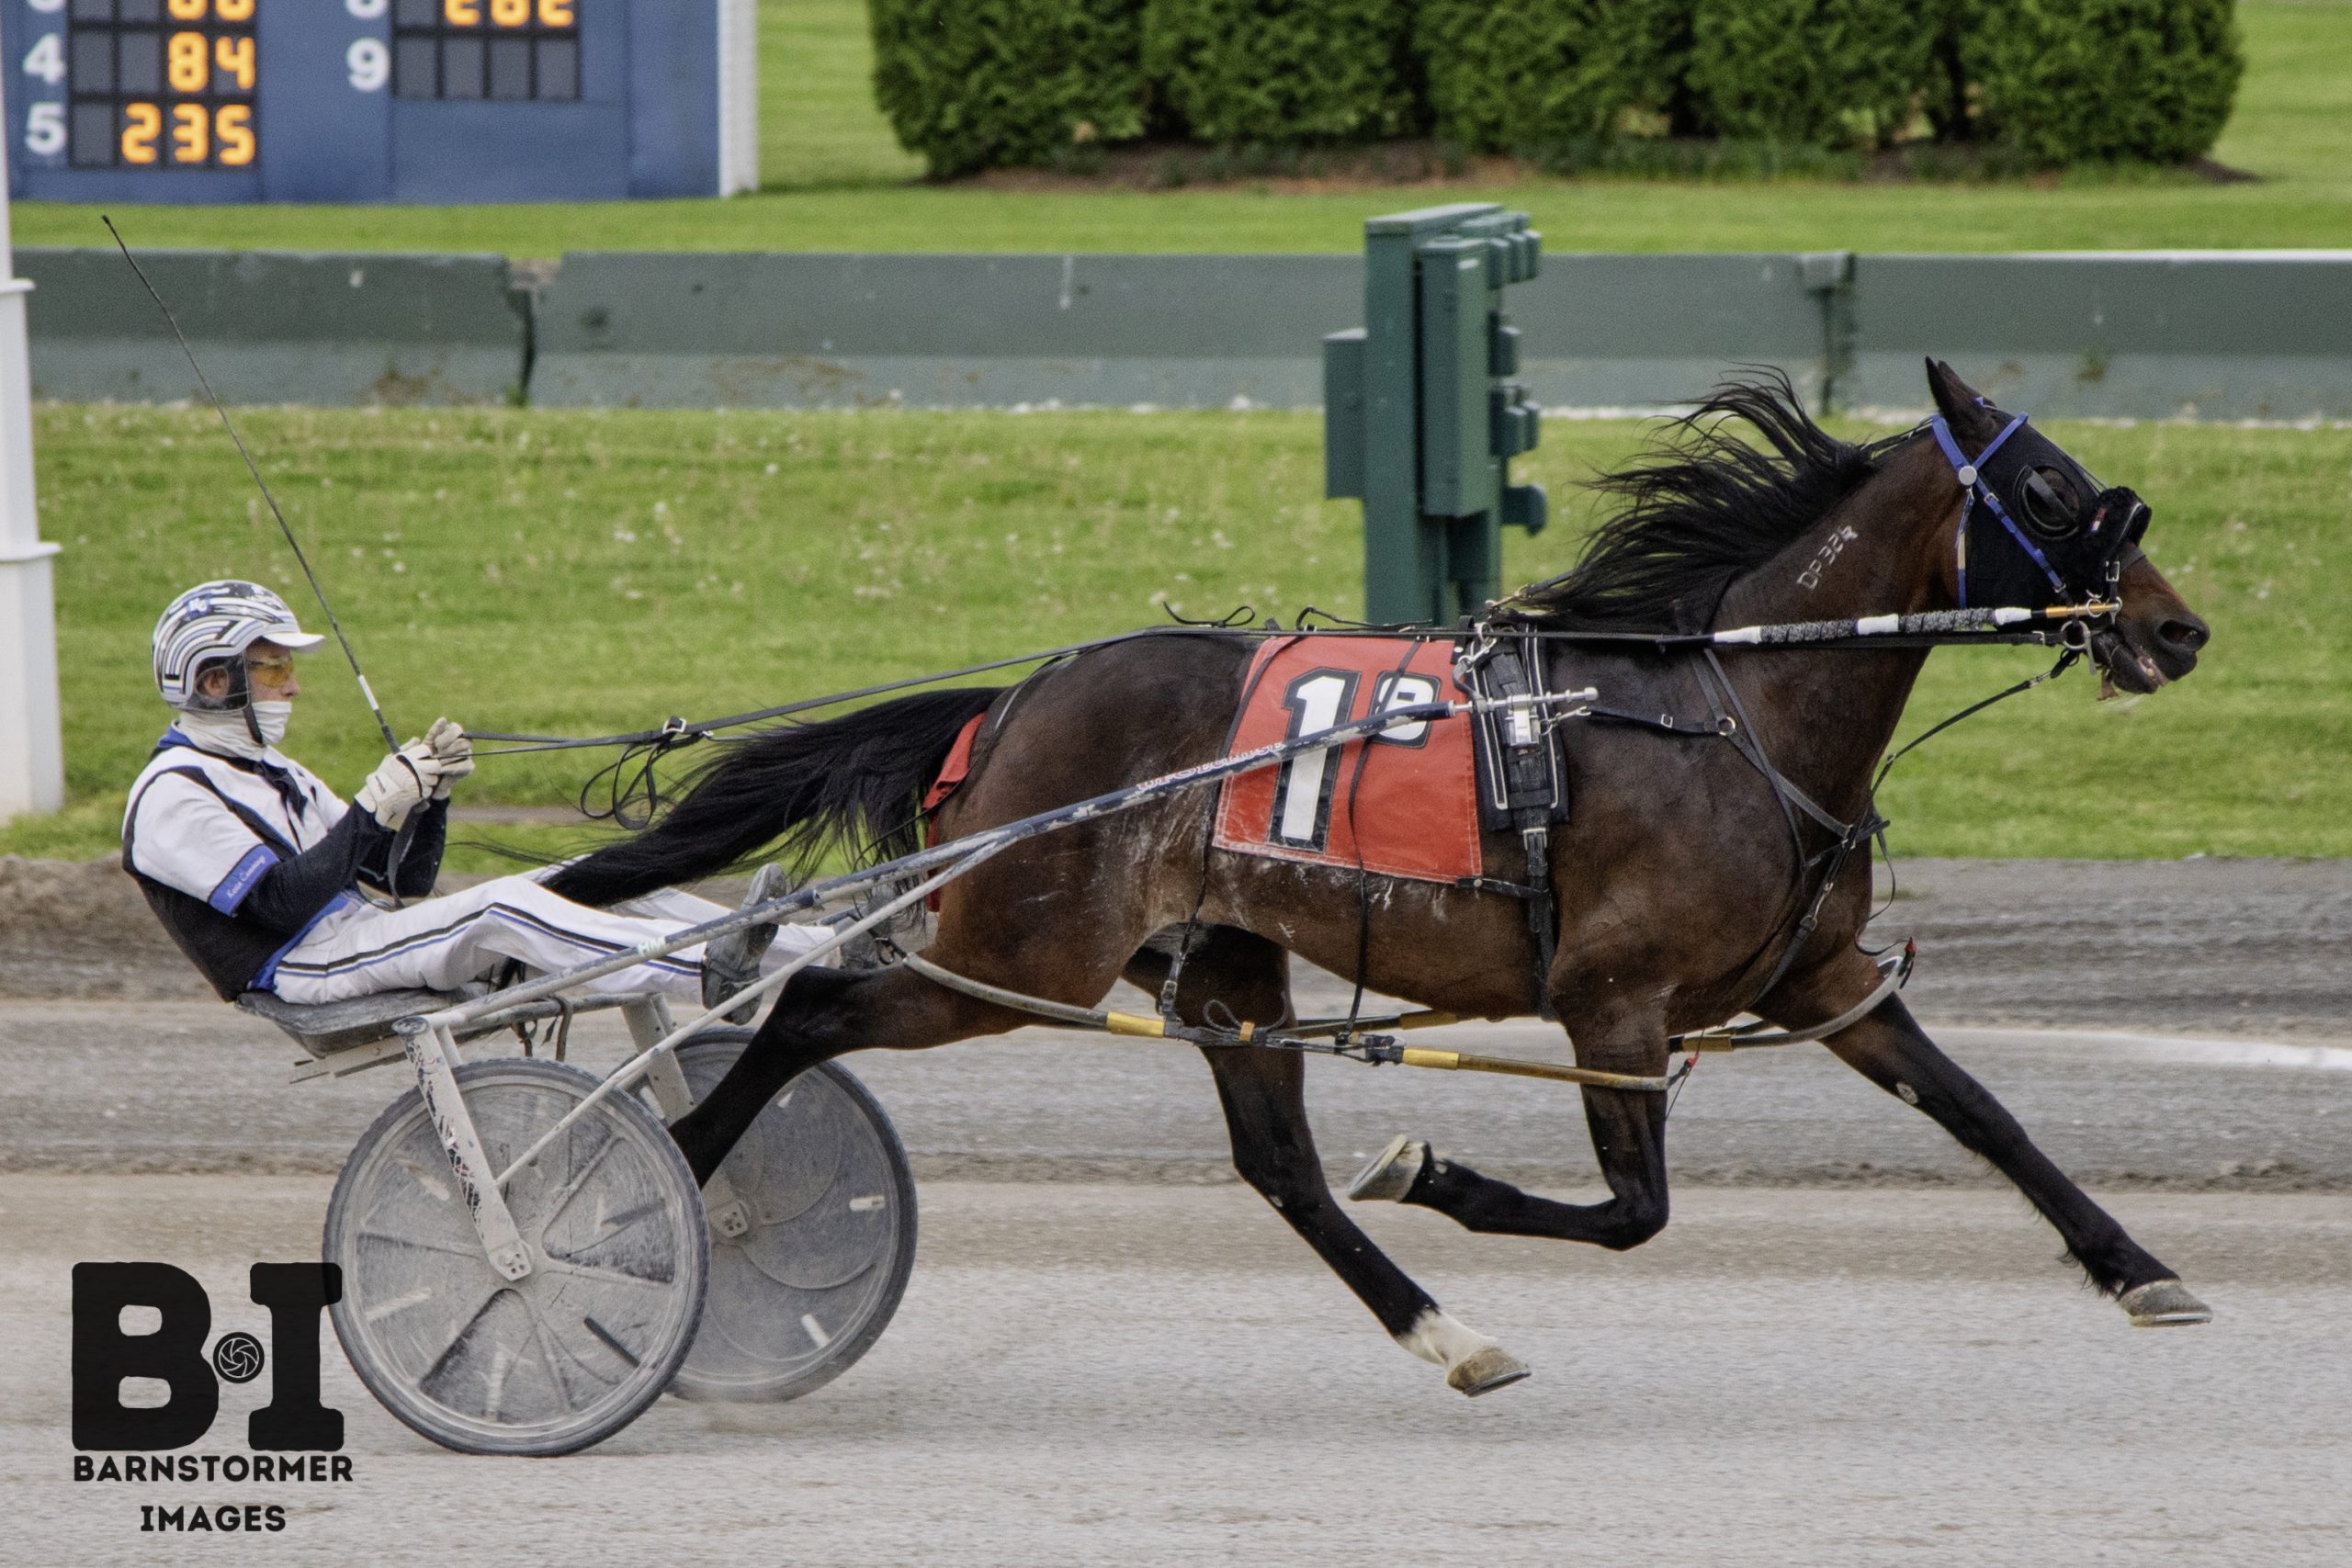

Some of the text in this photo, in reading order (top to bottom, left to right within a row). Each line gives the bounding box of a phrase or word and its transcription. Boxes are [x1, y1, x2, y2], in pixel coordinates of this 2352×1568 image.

[22, 30, 255, 93] 4 84
[345, 37, 390, 92] 9
[24, 100, 255, 166] 5 235
[1274, 671, 1355, 847] 1
